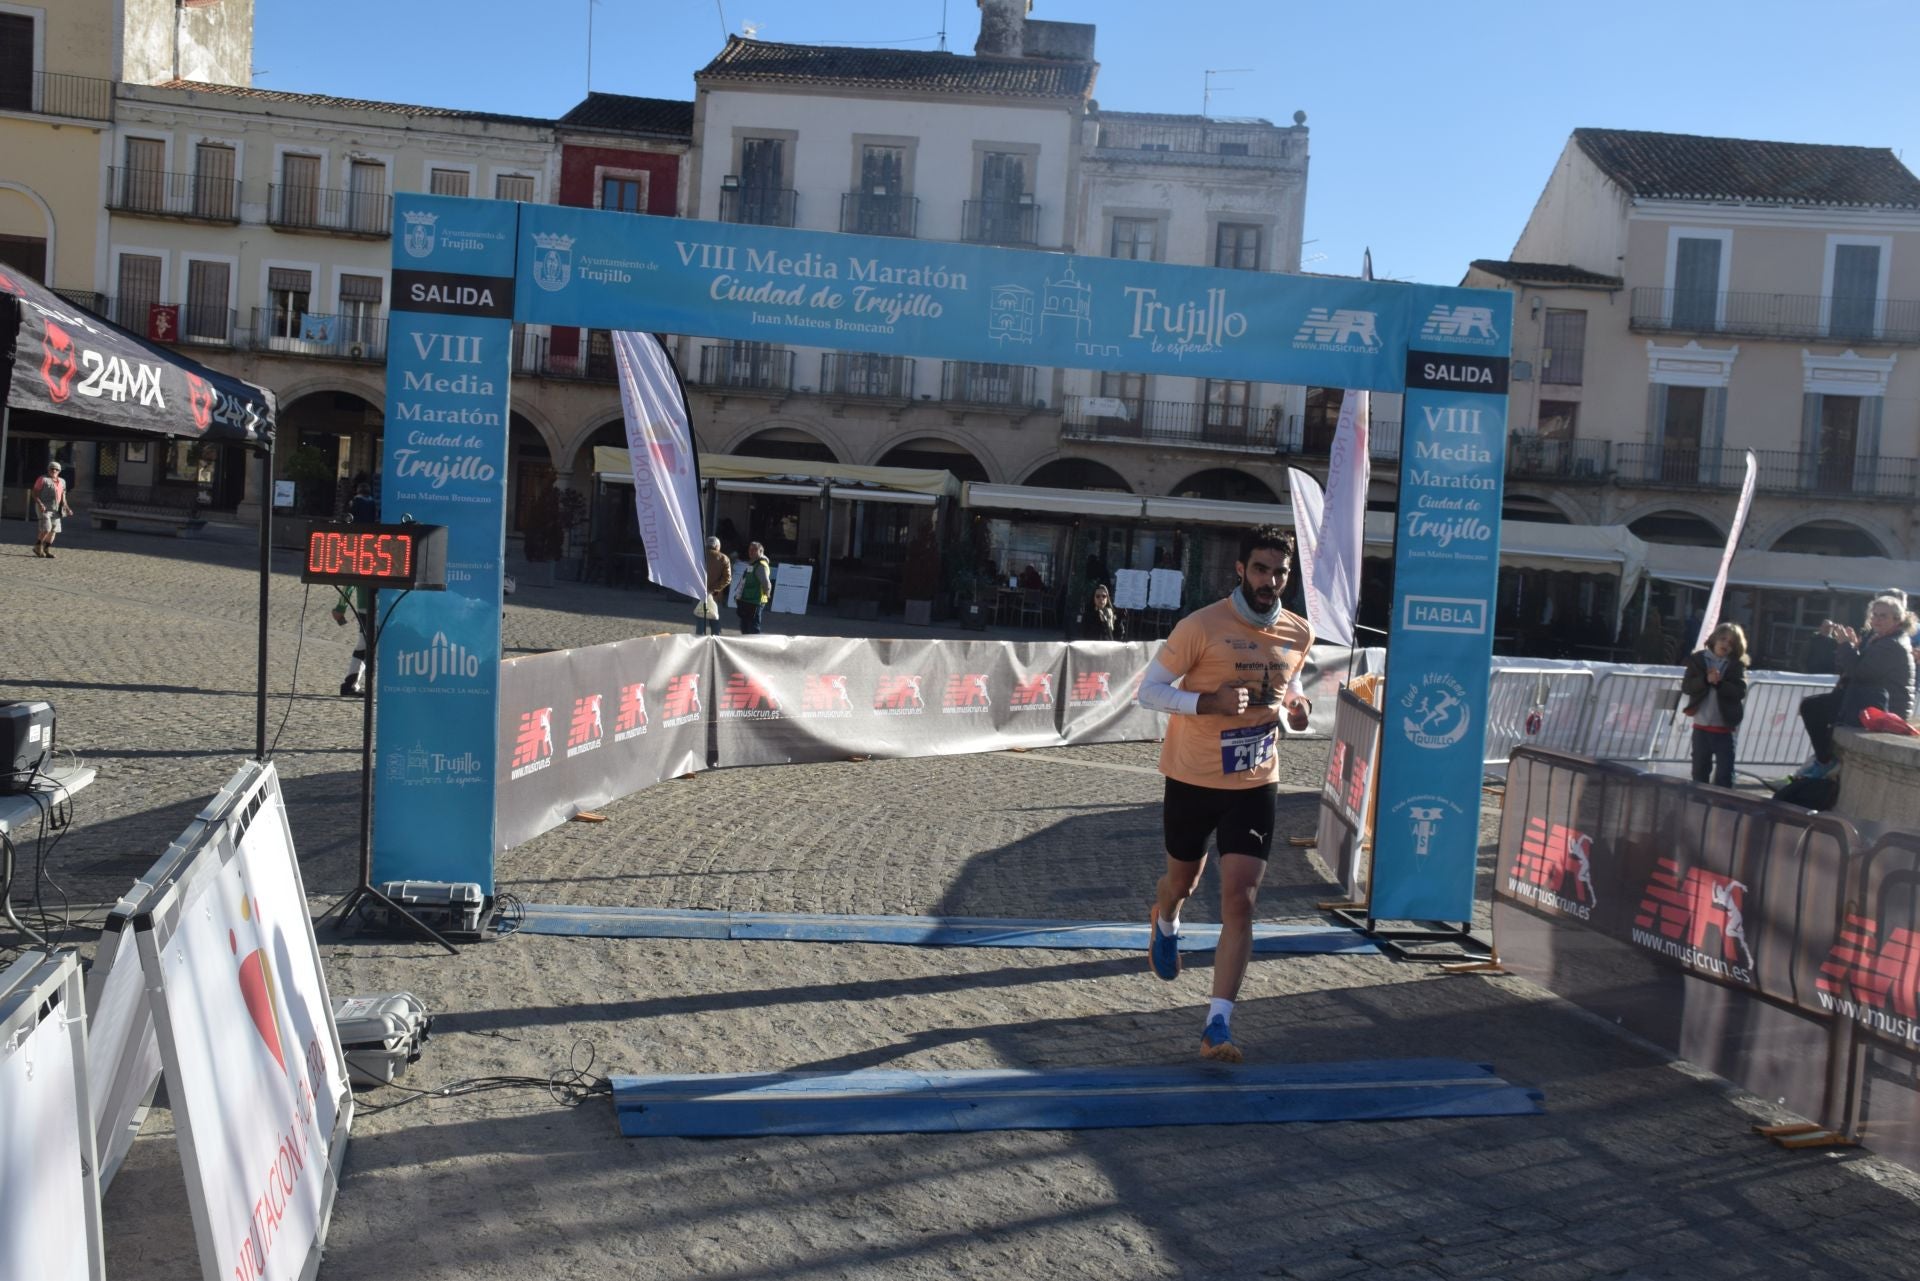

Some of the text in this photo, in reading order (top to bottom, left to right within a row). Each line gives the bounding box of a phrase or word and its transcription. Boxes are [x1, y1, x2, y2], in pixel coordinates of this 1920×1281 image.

[440, 237, 484, 250] Trujillo
[579, 255, 659, 272] Ayuntamiento de
[674, 241, 969, 291] VIII Media Maratón
[578, 266, 632, 285] Trujillo
[410, 283, 494, 307] SALIDA
[709, 274, 943, 325] Ciudad de Trujillo
[751, 311, 895, 335] Juan Mateos Broncano
[1124, 286, 1248, 347] Trujillo
[410, 332, 483, 364] VIII
[1152, 335, 1166, 353] te
[1292, 341, 1380, 354] www.musicrun.es
[1420, 333, 1496, 346] www.musicrun.es
[77, 349, 166, 409] 24MX
[403, 370, 494, 396] Media
[1423, 363, 1494, 384] SALIDA
[396, 402, 500, 426] Maratón
[1422, 406, 1483, 434] VIII
[407, 430, 484, 449] Ciudad de
[1415, 441, 1492, 463] Media
[393, 448, 495, 489] Trujillo
[1409, 468, 1496, 490] Maratón
[397, 491, 492, 503] Juan Mateos Broncano
[1418, 494, 1481, 511] Ciudad de
[1406, 511, 1492, 548] Trujillo
[309, 531, 412, 577] 00:46:57
[1408, 549, 1426, 558] Juan
[447, 570, 471, 583] jillo
[1415, 606, 1474, 624] HABLA
[397, 631, 480, 683] trujillo
[1235, 661, 1264, 671] Maratón
[1401, 672, 1466, 709] Club Atletismo
[719, 708, 780, 718] www.musicrun.es
[431, 752, 481, 775] Trujillo
[511, 757, 551, 781] www.musicrun.es
[1508, 876, 1591, 921] www.musicrun.es
[1632, 927, 1751, 983] www.musicrun.es
